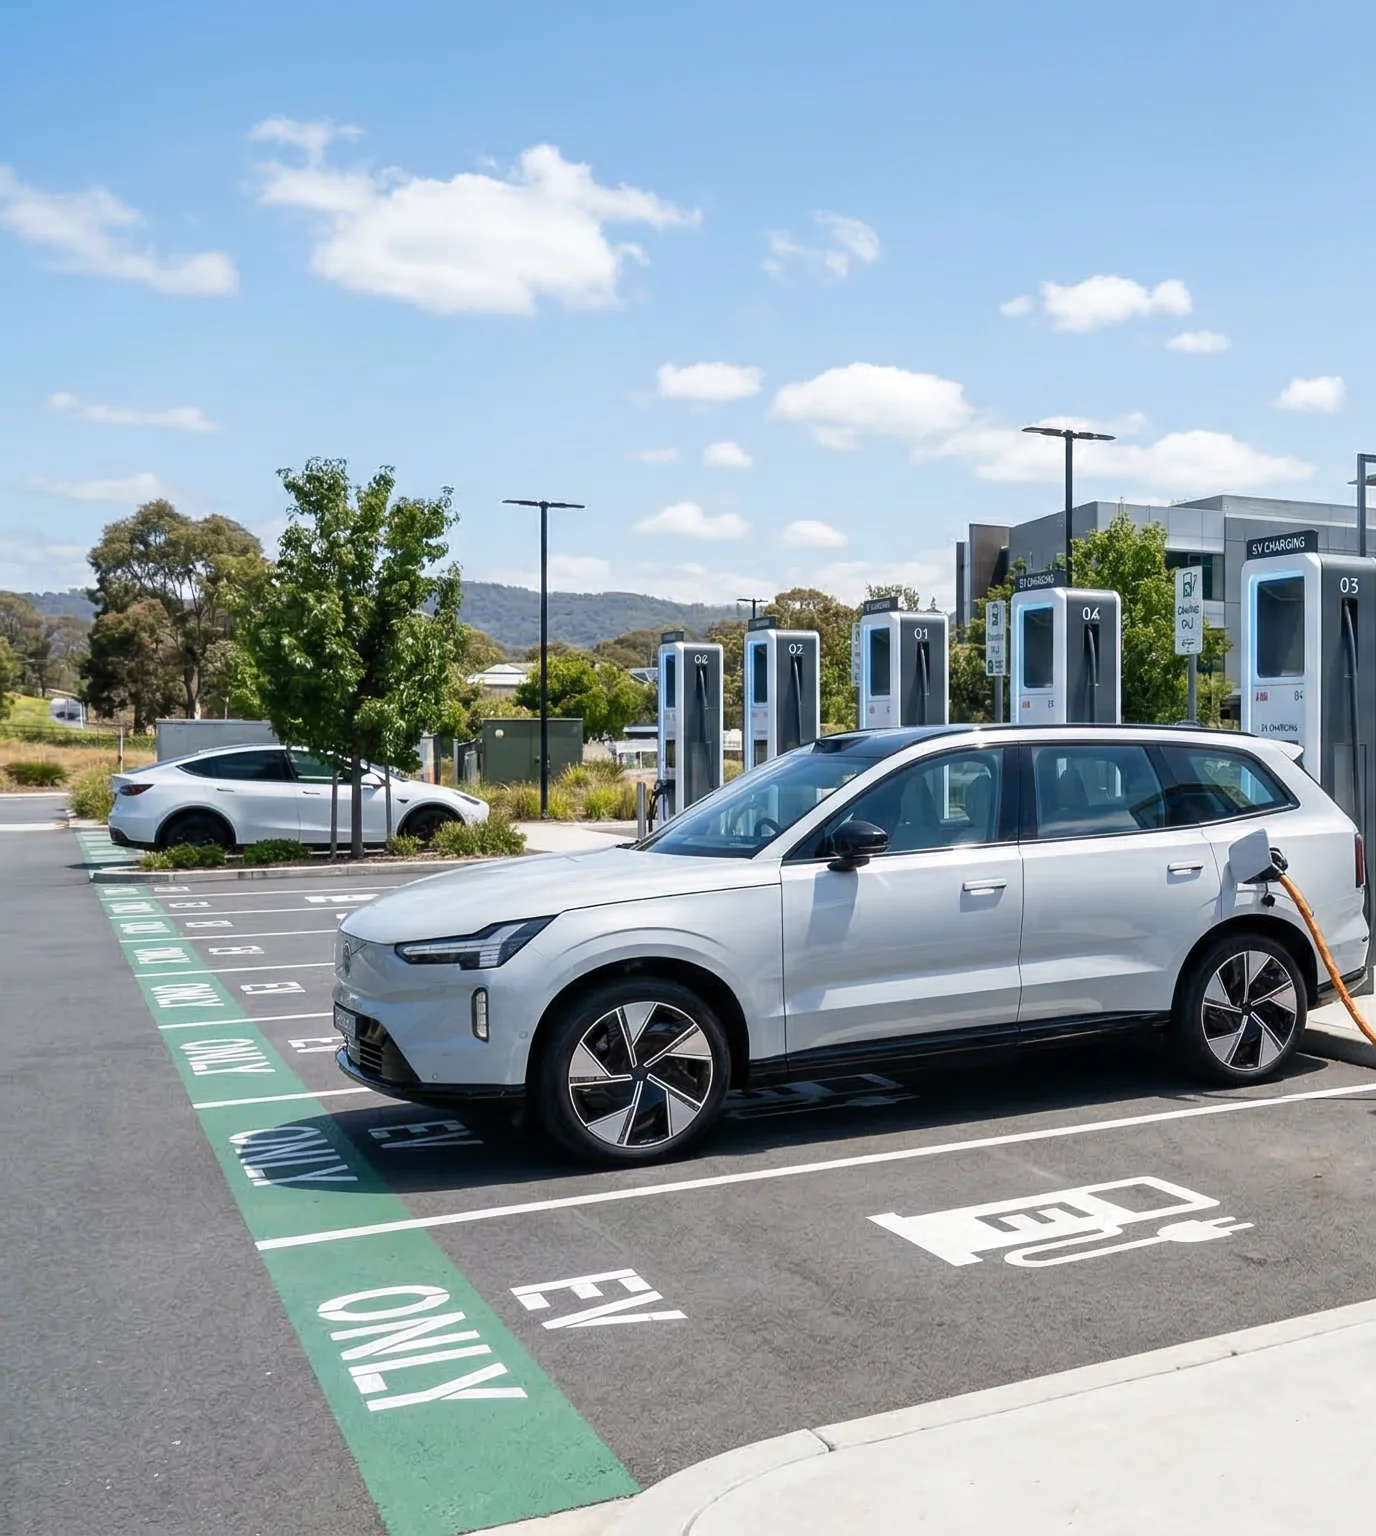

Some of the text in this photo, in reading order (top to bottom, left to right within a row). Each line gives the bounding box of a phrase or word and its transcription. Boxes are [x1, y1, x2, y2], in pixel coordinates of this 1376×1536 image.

[1264, 536, 1305, 553] CHARGING
[1339, 577, 1359, 594] 03
[914, 627, 928, 640] 01
[179, 1038, 277, 1076] ONLY
[367, 1120, 485, 1148] EV
[228, 1126, 358, 1187] ONLY
[509, 1268, 688, 1330] EV
[317, 1285, 528, 1412] ONLY
